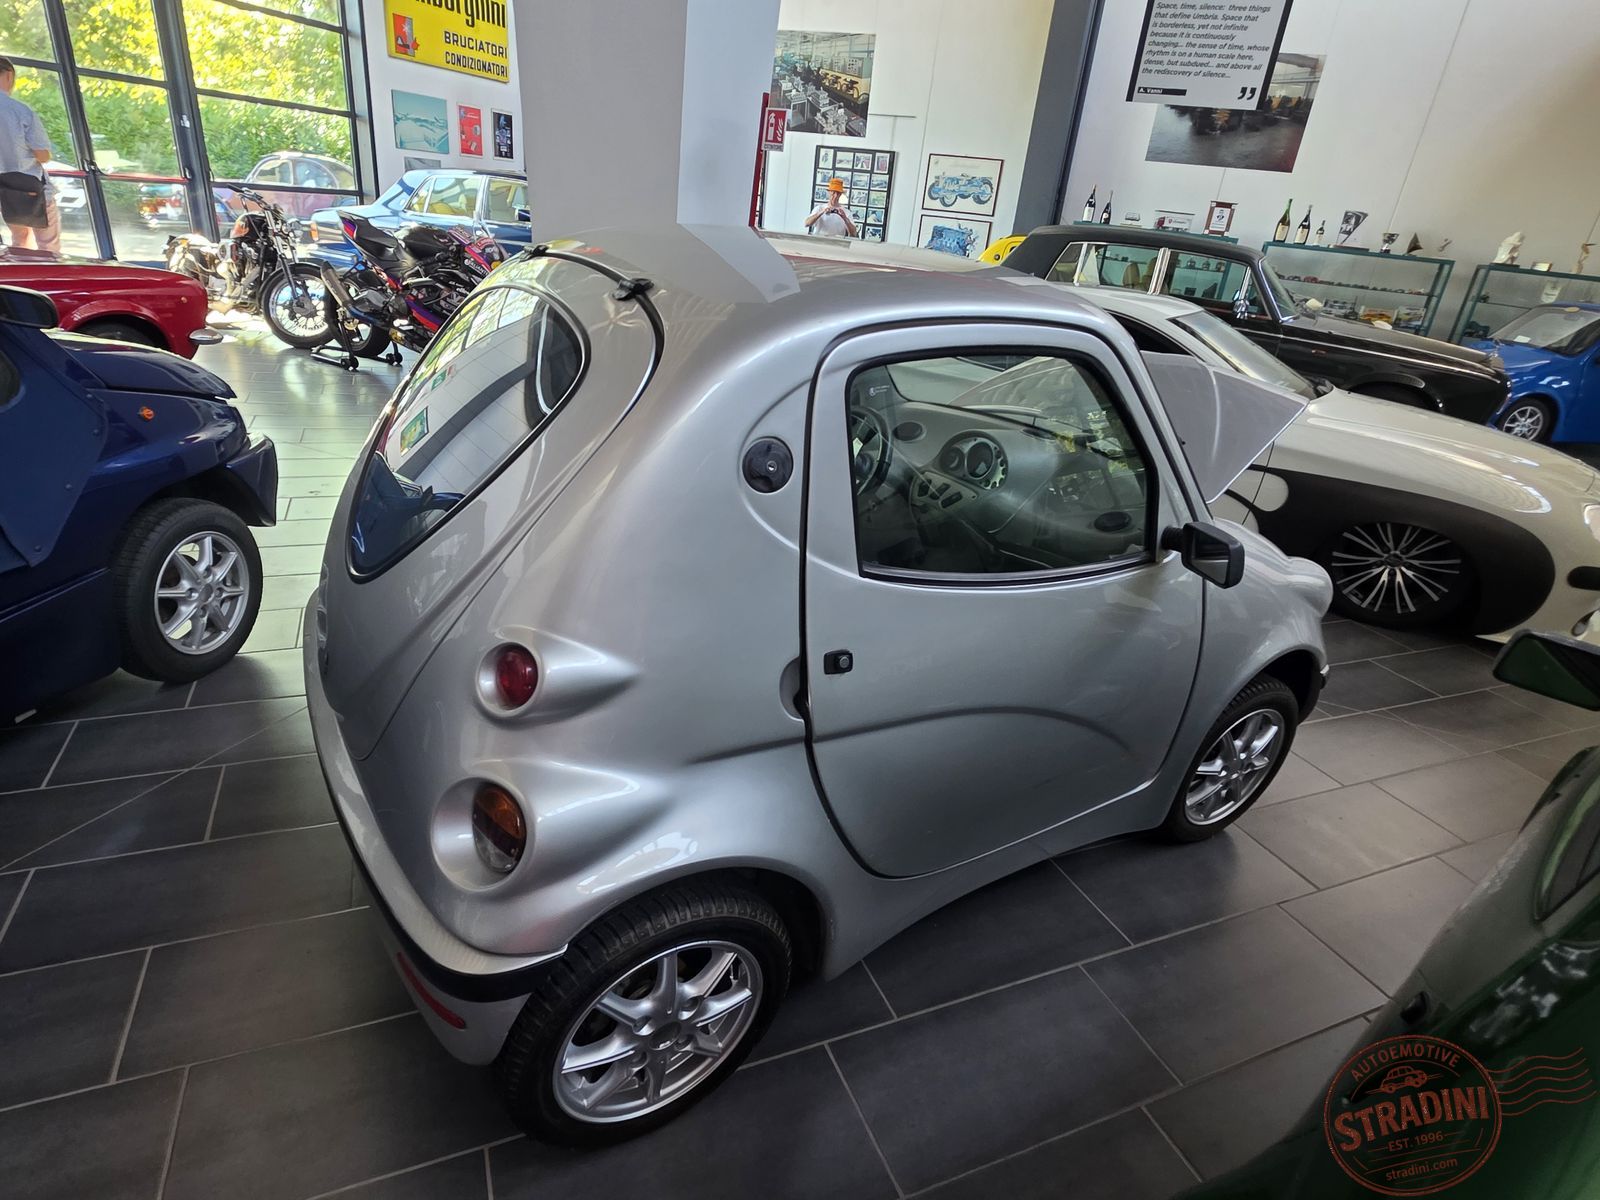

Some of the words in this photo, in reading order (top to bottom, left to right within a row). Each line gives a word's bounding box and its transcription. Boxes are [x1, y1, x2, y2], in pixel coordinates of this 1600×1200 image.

[1248, 5, 1271, 13] things
[1159, 21, 1195, 29] borderless,
[1223, 23, 1249, 31] infinite
[1191, 33, 1236, 41] continuously
[443, 30, 508, 59] BRUCIATORI
[1228, 43, 1245, 51] time,
[1146, 49, 1170, 57] rhythm
[1193, 51, 1217, 59] human
[1236, 53, 1254, 61] here,
[445, 51, 508, 78] CONDIZIONATORI
[1144, 58, 1165, 66] dense,
[1153, 68, 1193, 77] rediscovery
